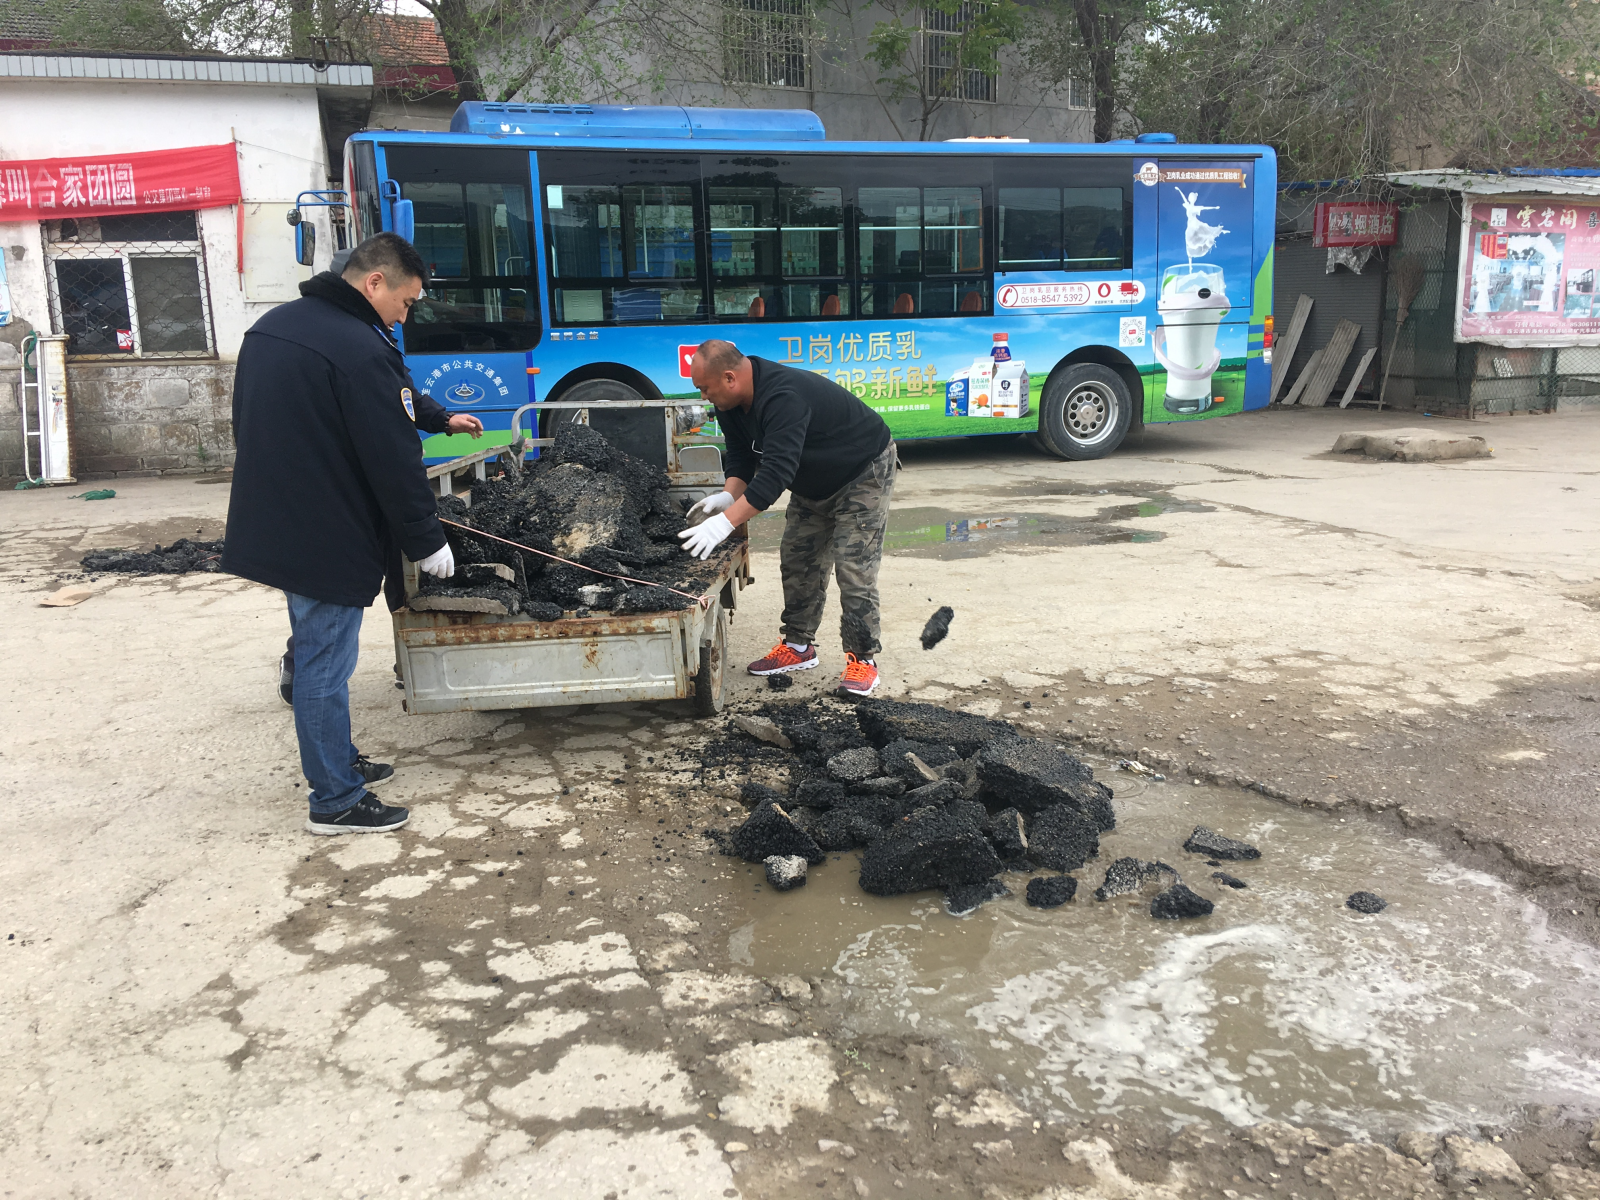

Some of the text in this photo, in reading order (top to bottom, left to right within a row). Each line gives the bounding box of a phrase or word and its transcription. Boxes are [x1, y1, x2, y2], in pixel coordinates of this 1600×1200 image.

[0, 163, 137, 209] 叫合家团圆
[1021, 286, 1083, 294] 卫岗乳品服务热线
[1063, 293, 1084, 303] 5392
[778, 330, 921, 364] 卫岗优质乳
[809, 363, 938, 400] 够新鲜
